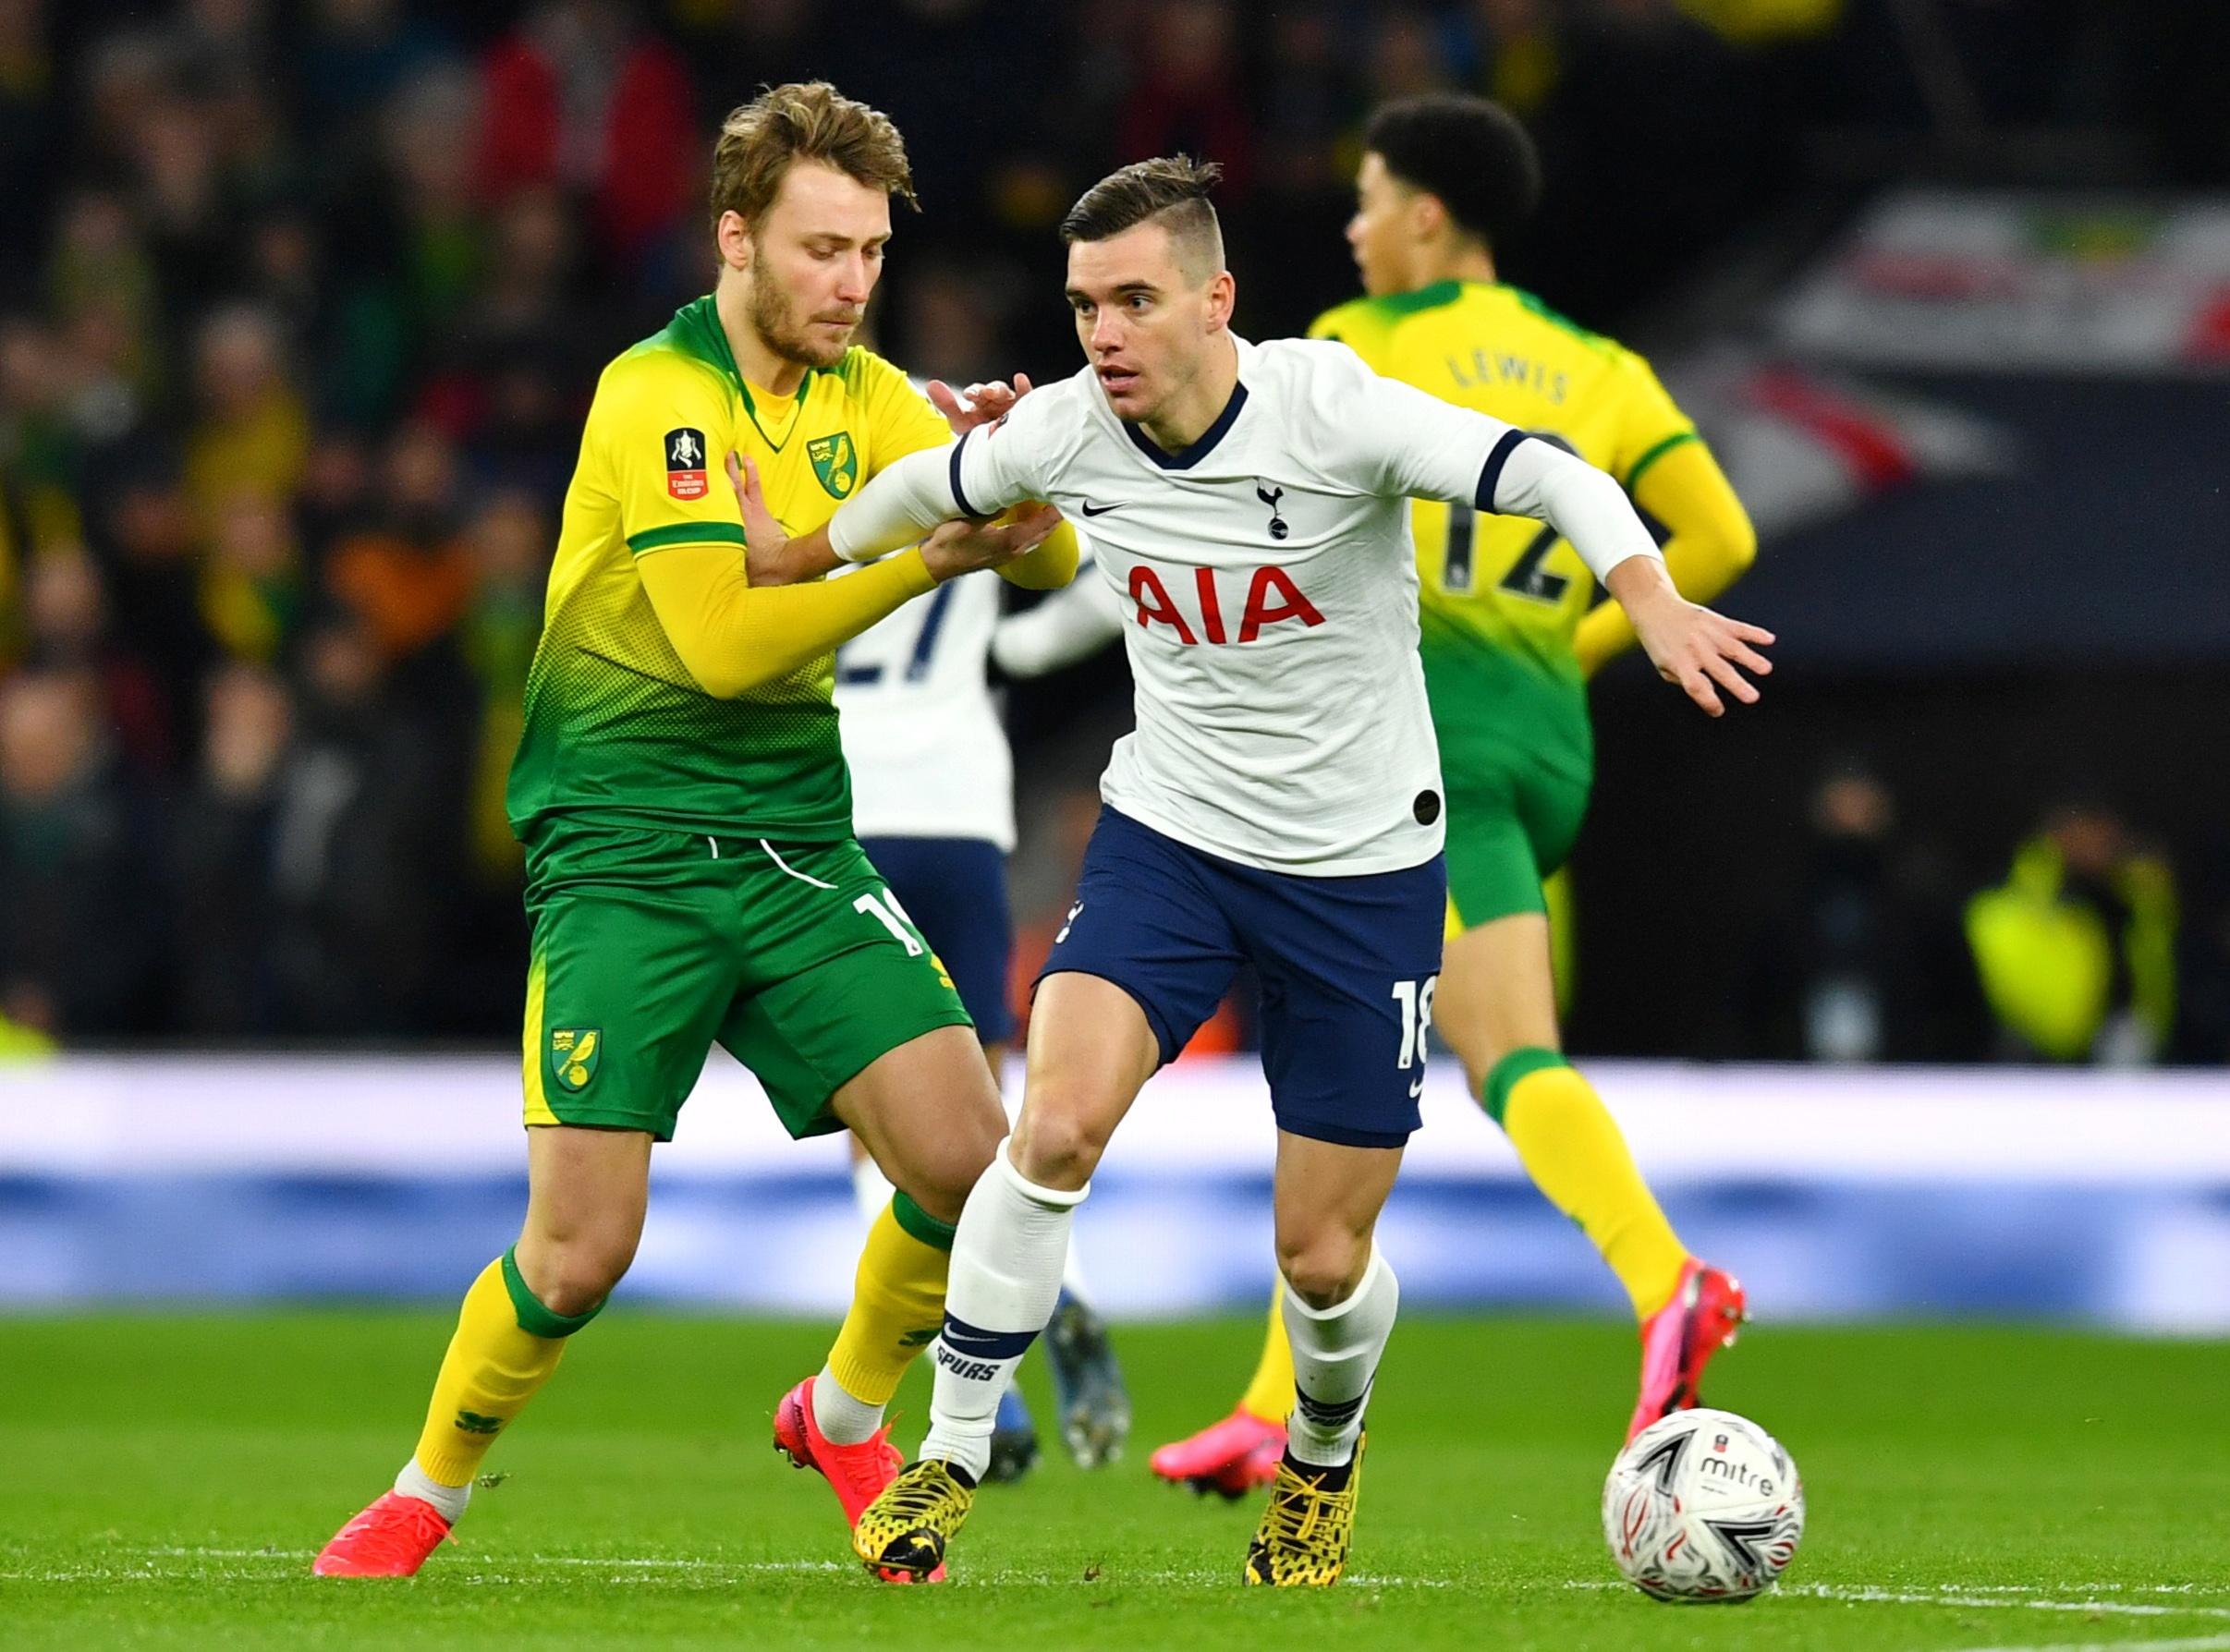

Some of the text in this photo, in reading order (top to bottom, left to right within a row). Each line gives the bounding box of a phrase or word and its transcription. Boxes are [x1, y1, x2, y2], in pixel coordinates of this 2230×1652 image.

[1445, 348, 1568, 405] LEWIS
[1128, 565, 1327, 645] AIA
[937, 1344, 1001, 1381] SPURS
[1700, 1457, 1773, 1497] mitre
